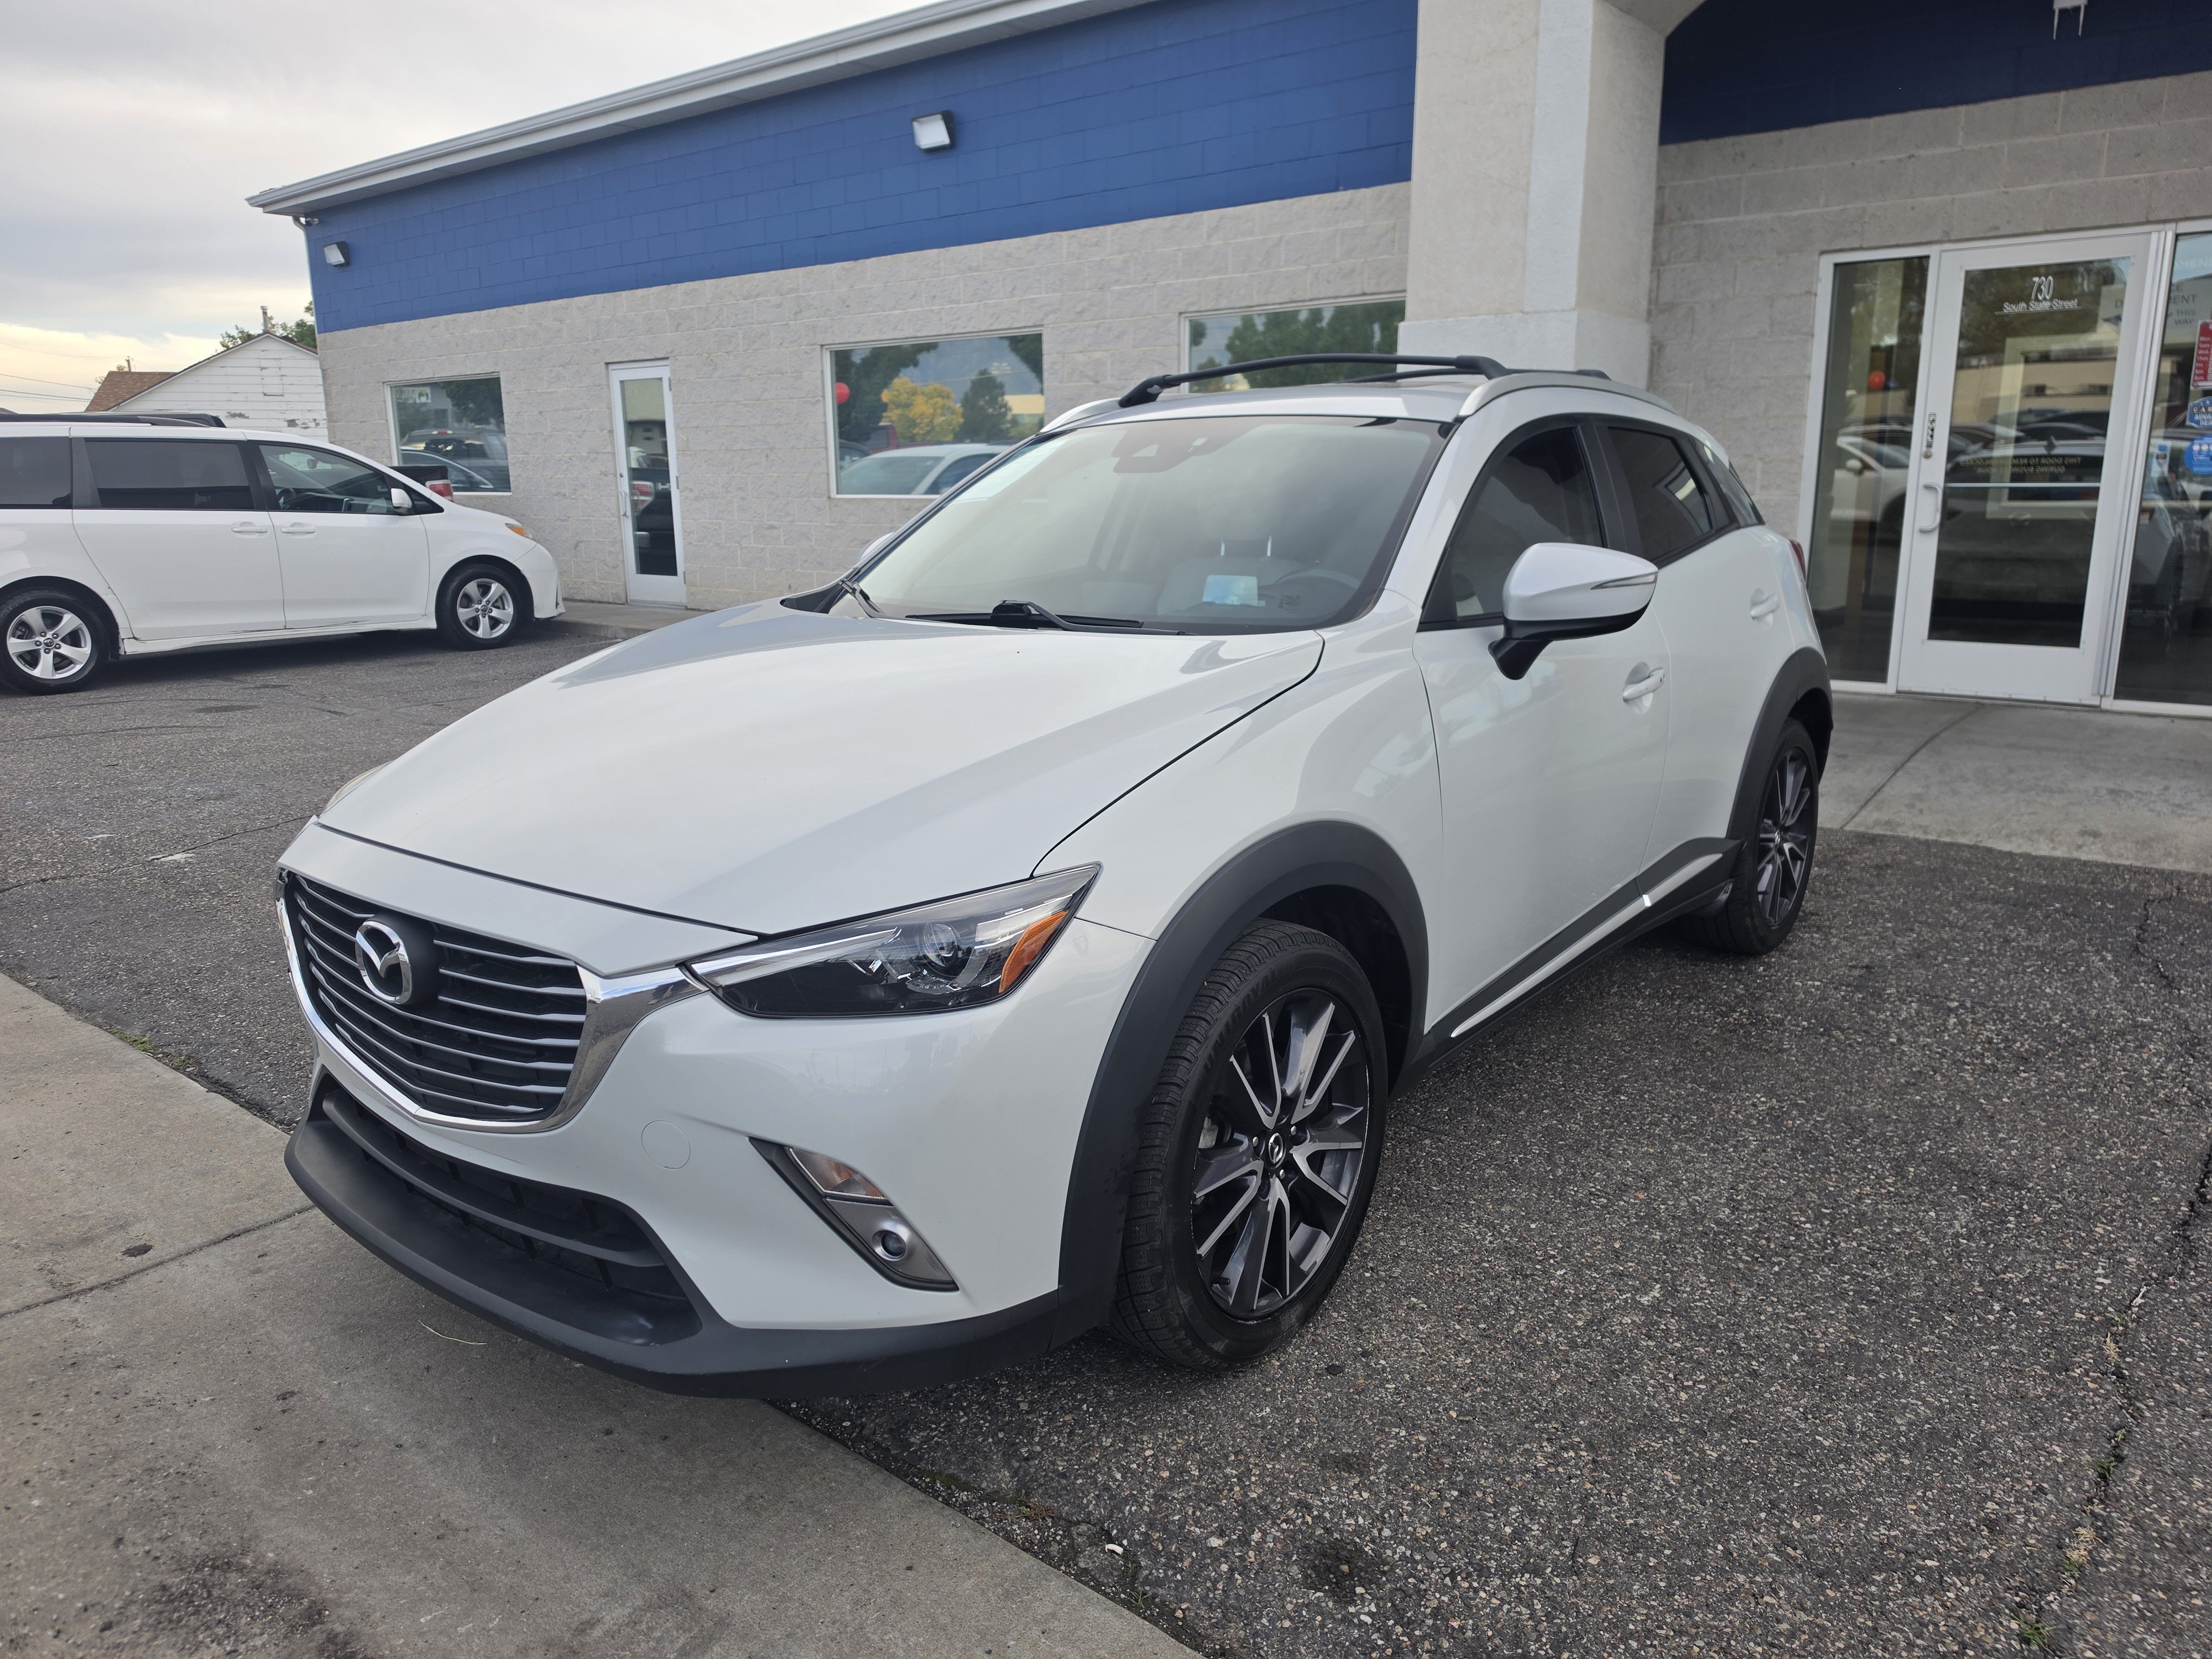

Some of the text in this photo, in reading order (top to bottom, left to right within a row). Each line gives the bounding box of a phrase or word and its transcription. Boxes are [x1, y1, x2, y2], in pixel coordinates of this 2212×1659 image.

[2031, 275, 2054, 300] 730
[2003, 298, 2078, 313] South State Street
